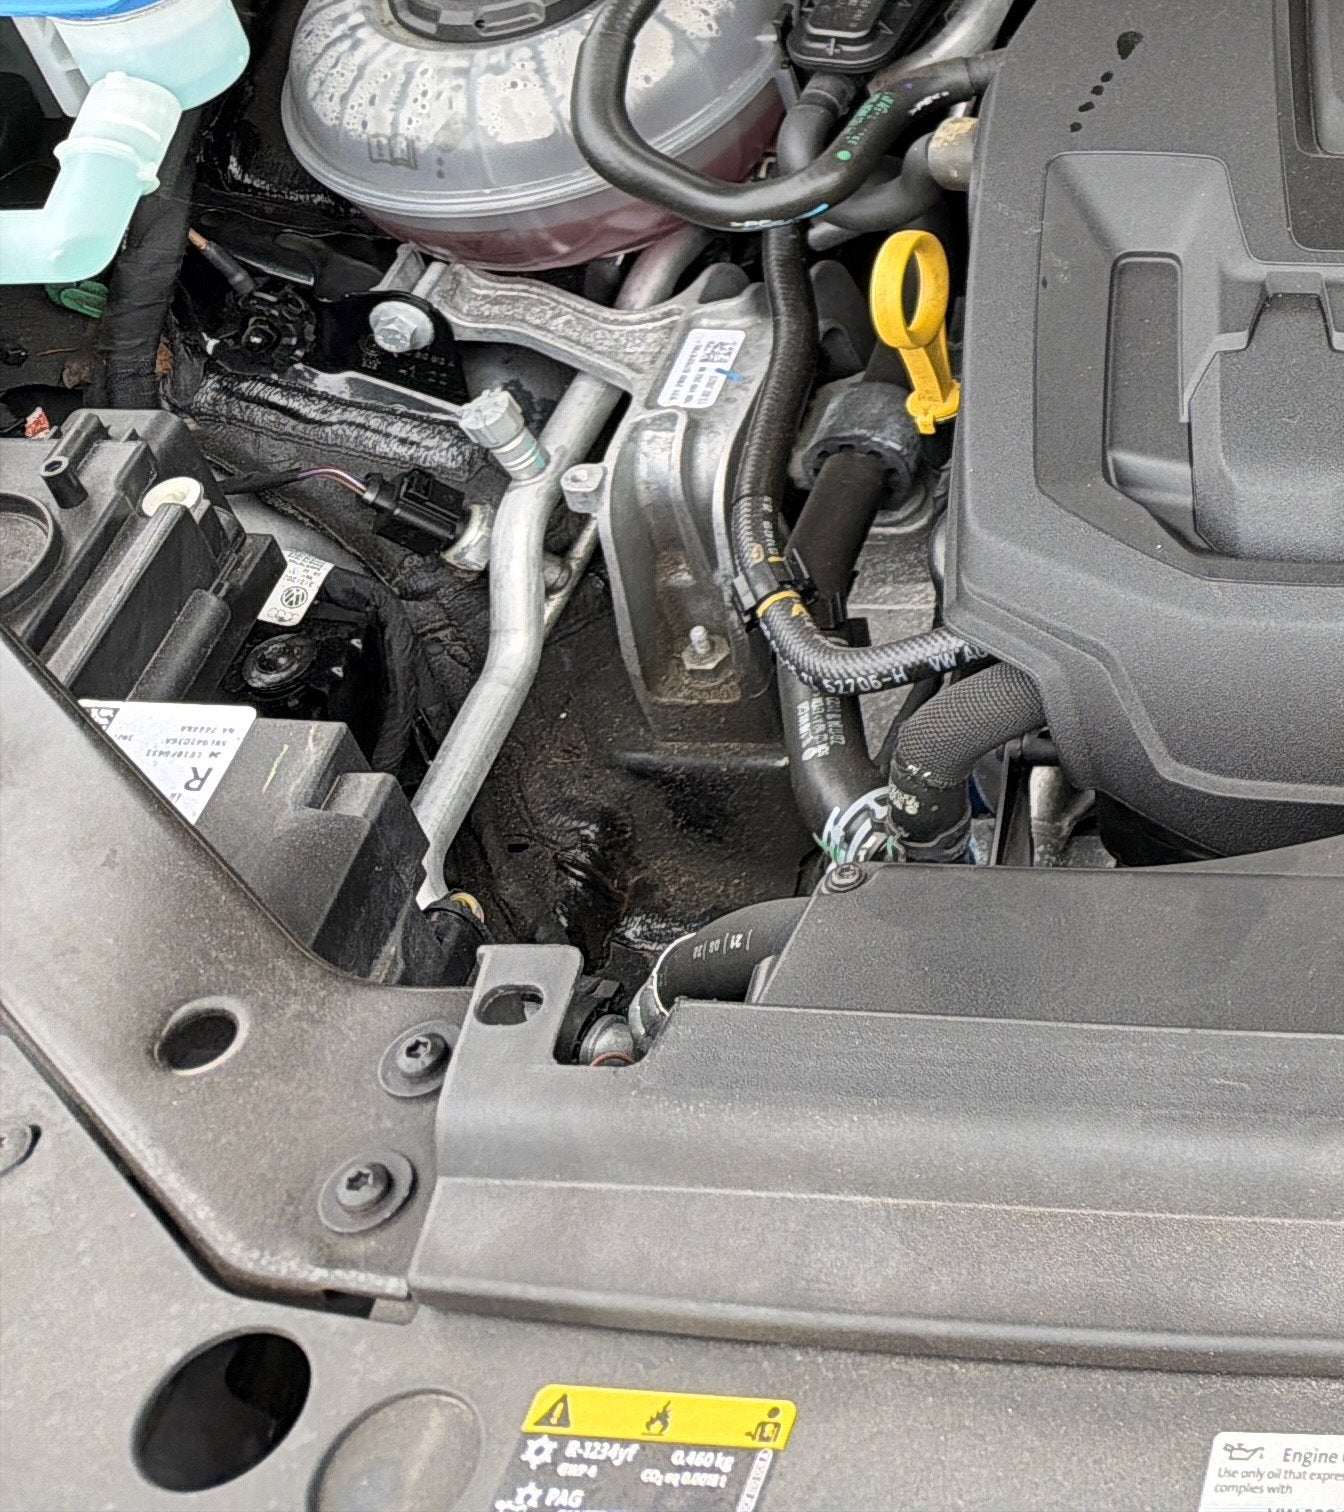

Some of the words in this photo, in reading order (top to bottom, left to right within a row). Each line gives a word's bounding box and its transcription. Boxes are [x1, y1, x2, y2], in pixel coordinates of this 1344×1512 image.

[822, 665, 908, 695] 52706-H
[183, 766, 213, 792] R
[1282, 1447, 1339, 1468] Engine
[1217, 1467, 1239, 1479] Use
[1241, 1467, 1265, 1480] only
[1267, 1468, 1282, 1480] oil
[1283, 1469, 1308, 1481] that
[545, 1487, 585, 1508] PAG
[1214, 1483, 1264, 1496] complies
[1266, 1483, 1293, 1494] with
